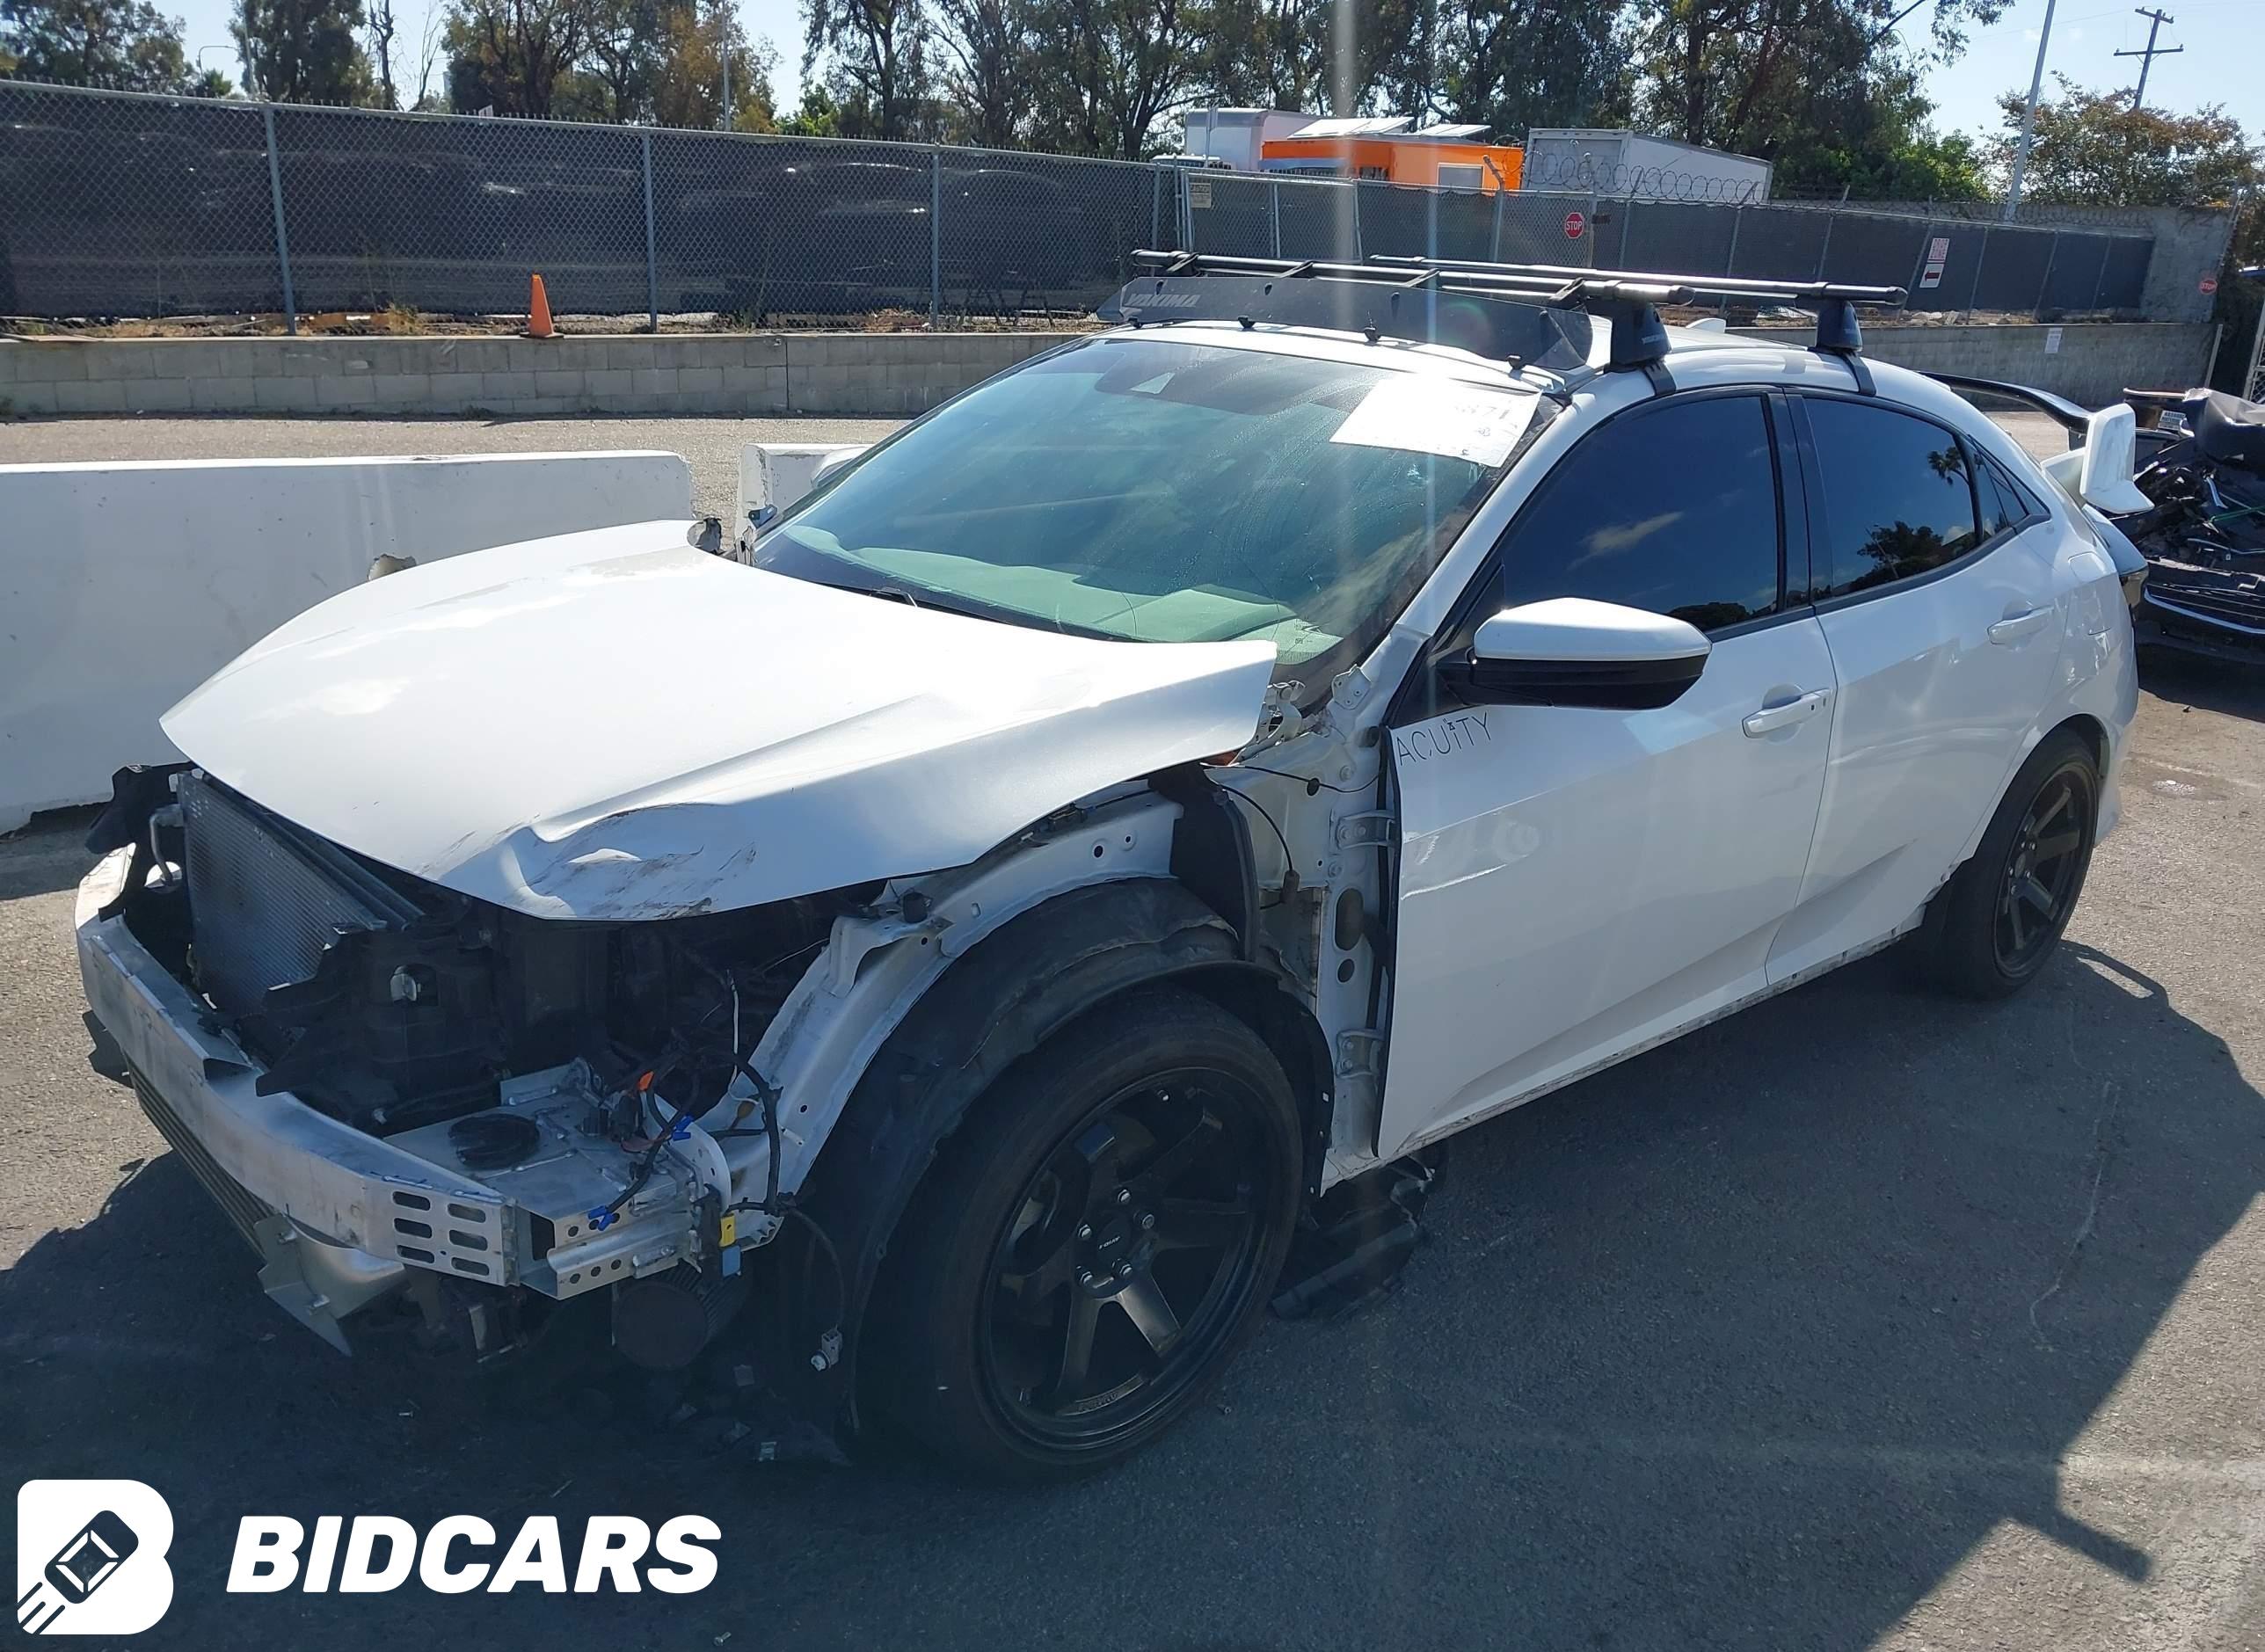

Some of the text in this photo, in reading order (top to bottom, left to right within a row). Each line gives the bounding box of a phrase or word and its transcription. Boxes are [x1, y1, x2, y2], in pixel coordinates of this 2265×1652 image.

[1566, 221, 1583, 231] STOP
[1124, 294, 1201, 308] YAKIMA
[1396, 712, 1491, 766] ACUITY
